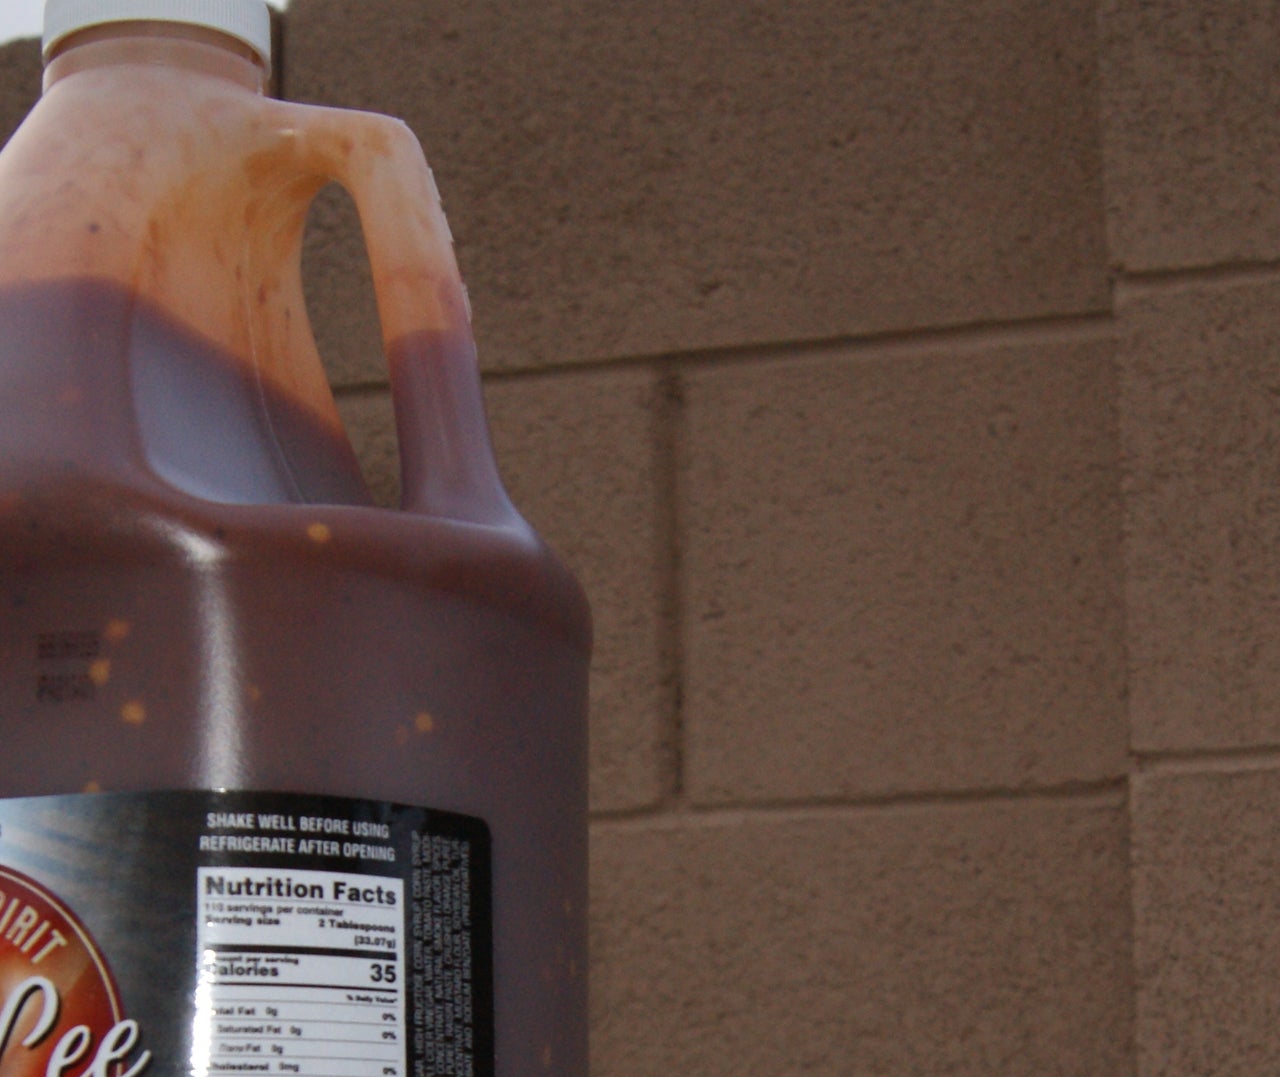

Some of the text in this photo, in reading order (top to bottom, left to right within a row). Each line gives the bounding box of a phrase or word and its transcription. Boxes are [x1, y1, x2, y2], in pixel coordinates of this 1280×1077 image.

[207, 812, 390, 839] SHAKE WELL BEFORE USING
[199, 835, 396, 862] REFRIGERATE AFTER OPENING
[205, 876, 397, 905] Nutrition Facts
[227, 903, 273, 916] servings
[276, 906, 293, 917] per
[296, 906, 344, 917] container
[256, 916, 280, 926] size
[330, 919, 395, 933] Tablespoons
[370, 963, 397, 983] 35
[238, 1007, 256, 1016] Fat
